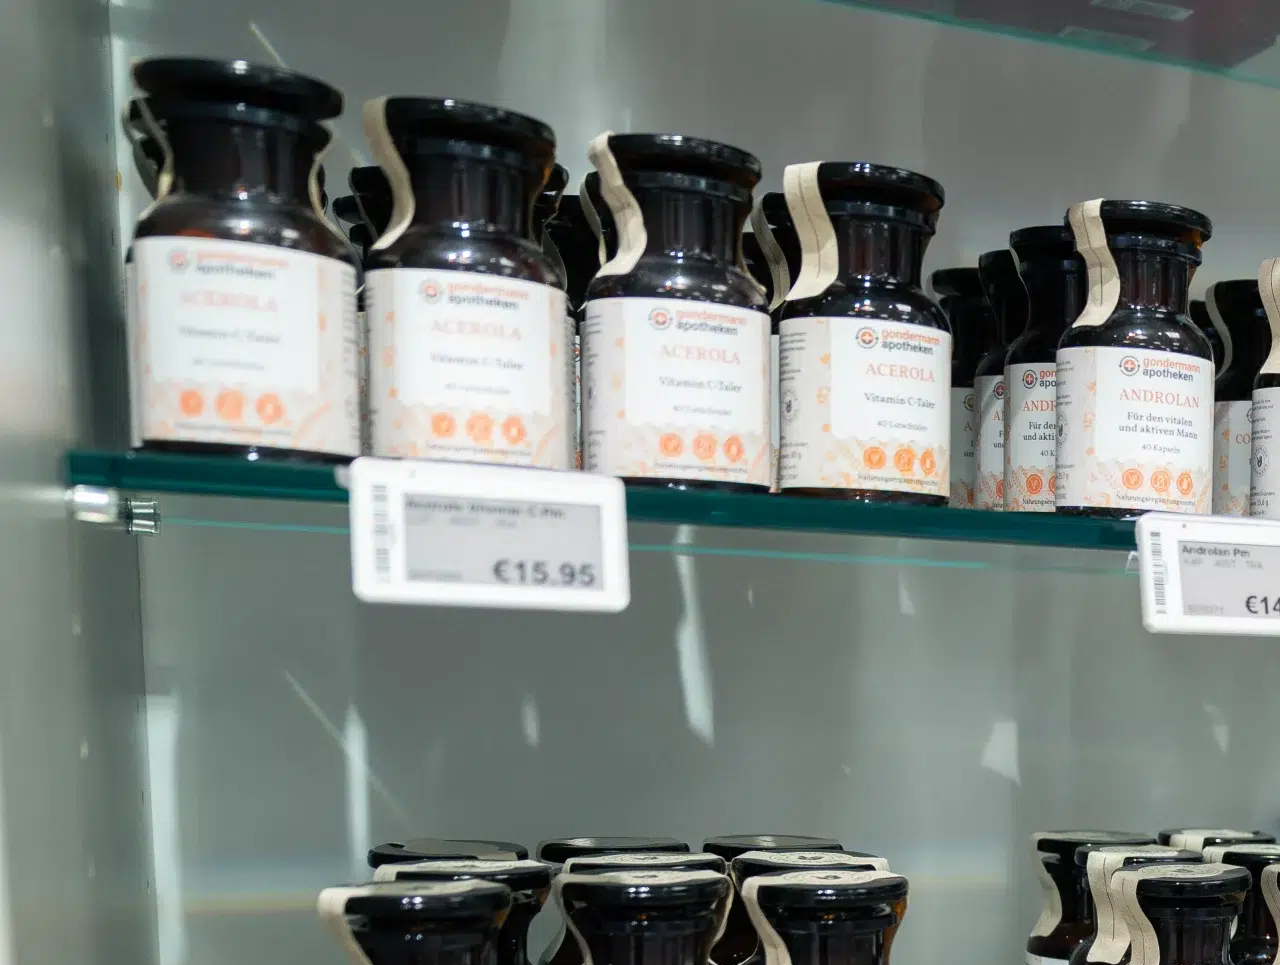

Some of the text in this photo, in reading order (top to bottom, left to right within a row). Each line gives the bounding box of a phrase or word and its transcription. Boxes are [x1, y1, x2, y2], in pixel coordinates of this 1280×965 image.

[659, 344, 741, 365] ACEROLA
[881, 340, 933, 356] apotheken
[866, 362, 935, 383] ACEROLA
[1143, 357, 1201, 374] gondermann
[1142, 367, 1194, 383] apotheken
[864, 392, 905, 406] Vitamin
[1120, 388, 1200, 409] ANDROLAN
[1127, 411, 1193, 428] Für den vitalen
[1119, 423, 1198, 440] und aktiven Mann
[1152, 443, 1181, 456] Kapseln
[1182, 544, 1250, 558] Androlan Pm
[492, 558, 596, 586] €15.95
